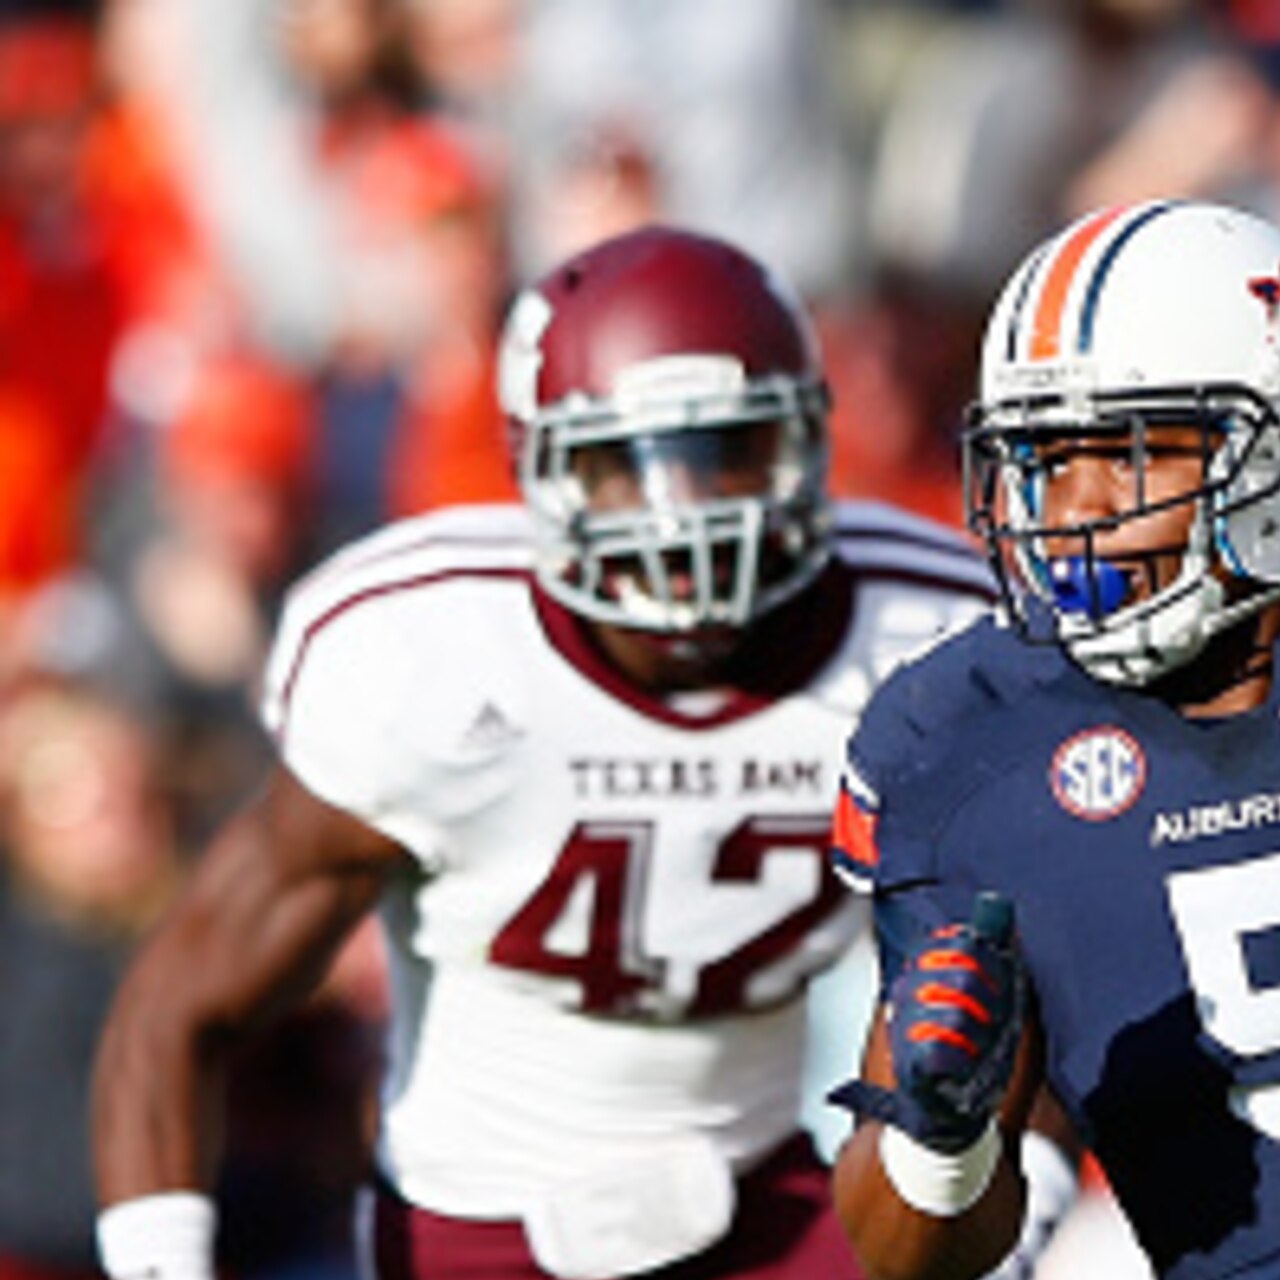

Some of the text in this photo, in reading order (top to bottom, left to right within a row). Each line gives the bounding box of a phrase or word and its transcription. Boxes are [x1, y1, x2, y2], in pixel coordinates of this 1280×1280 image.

[568, 757, 719, 796] TEXAS
[1054, 730, 1142, 815] SEC
[486, 812, 866, 1026] 42
